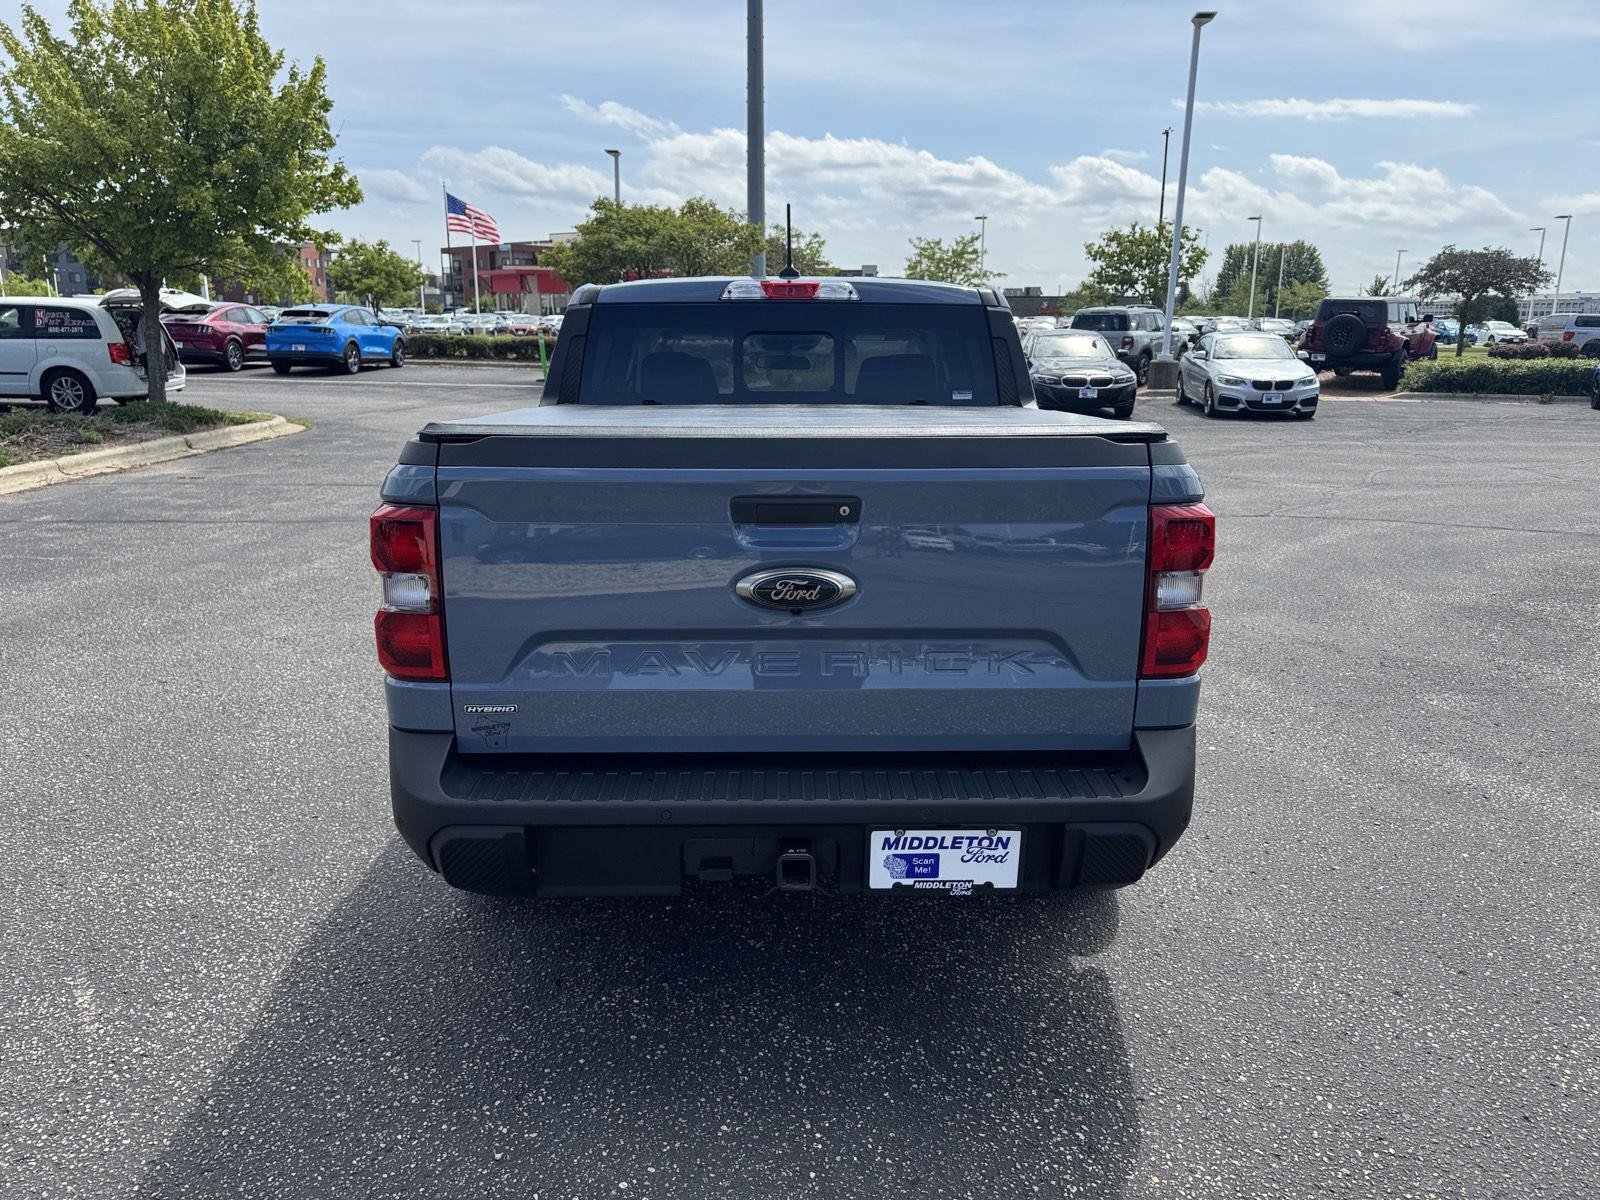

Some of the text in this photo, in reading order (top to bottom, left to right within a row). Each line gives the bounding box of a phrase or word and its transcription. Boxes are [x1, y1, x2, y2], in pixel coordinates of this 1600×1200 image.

[771, 579, 821, 601] Ford
[552, 649, 1039, 677] MAVERICK
[471, 722, 511, 732] MIDDLETON
[881, 836, 1011, 851] MIDDLETON
[961, 846, 1010, 864] Ford
[912, 857, 935, 865] Scan
[914, 866, 931, 874] Me!
[913, 881, 974, 890] MIDDLETON
[949, 888, 973, 896] Ford
